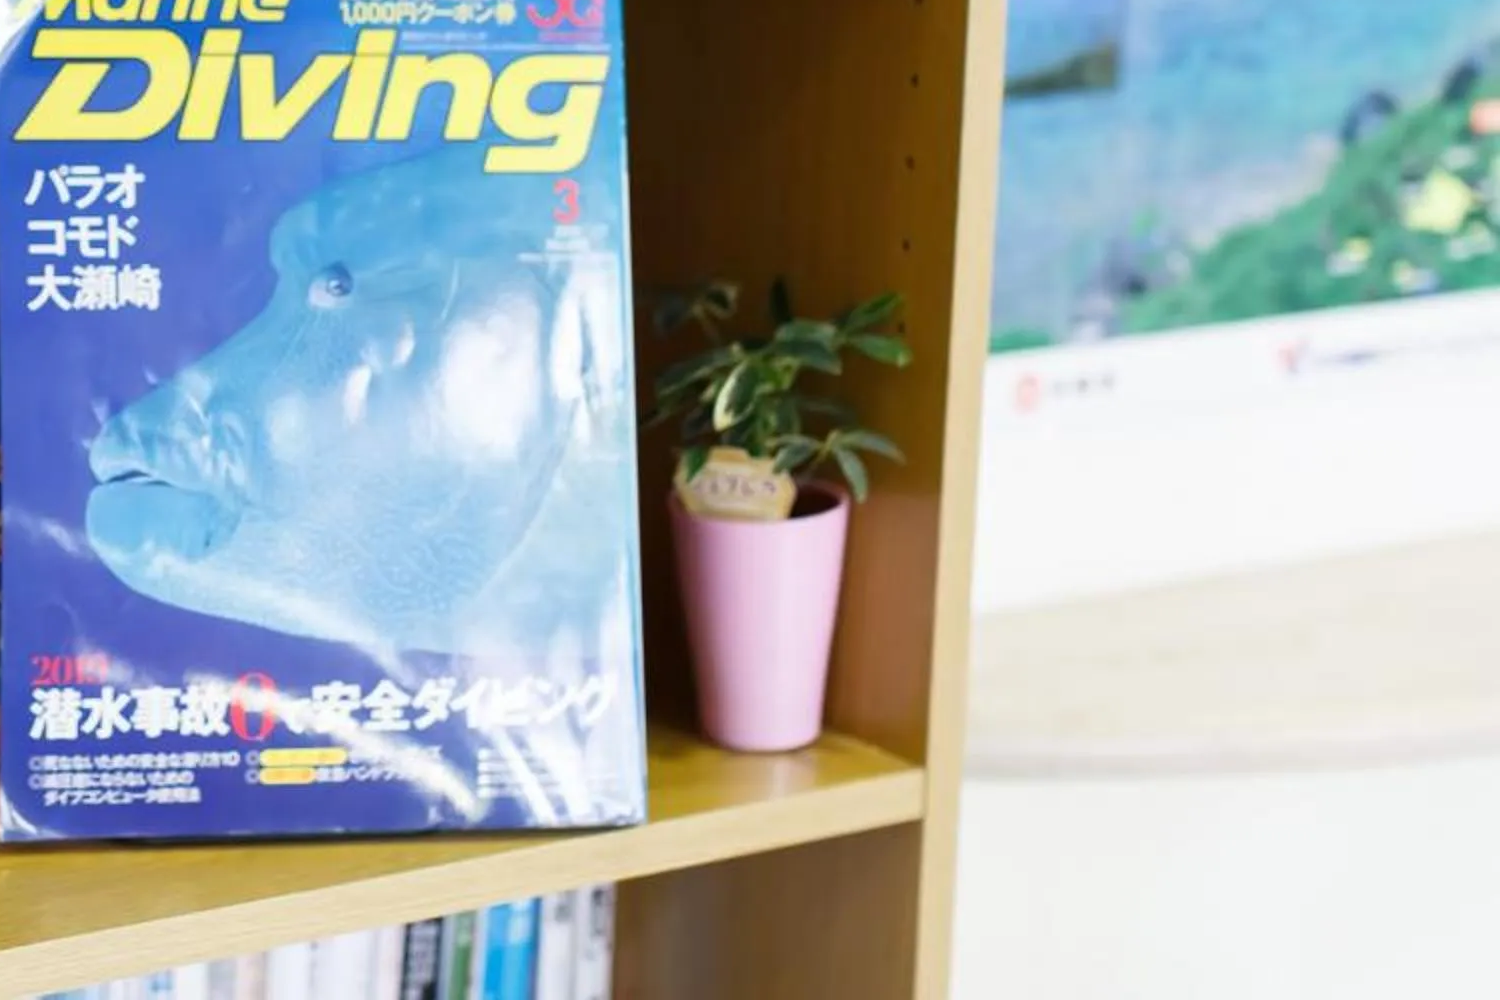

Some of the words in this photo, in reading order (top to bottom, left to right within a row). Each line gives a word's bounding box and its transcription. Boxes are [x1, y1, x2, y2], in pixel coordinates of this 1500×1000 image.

[13, 28, 612, 174] Diving
[24, 163, 146, 209] パラオ
[553, 179, 580, 225] 3
[27, 214, 140, 260] コモド
[26, 264, 162, 311] 大瀬崎
